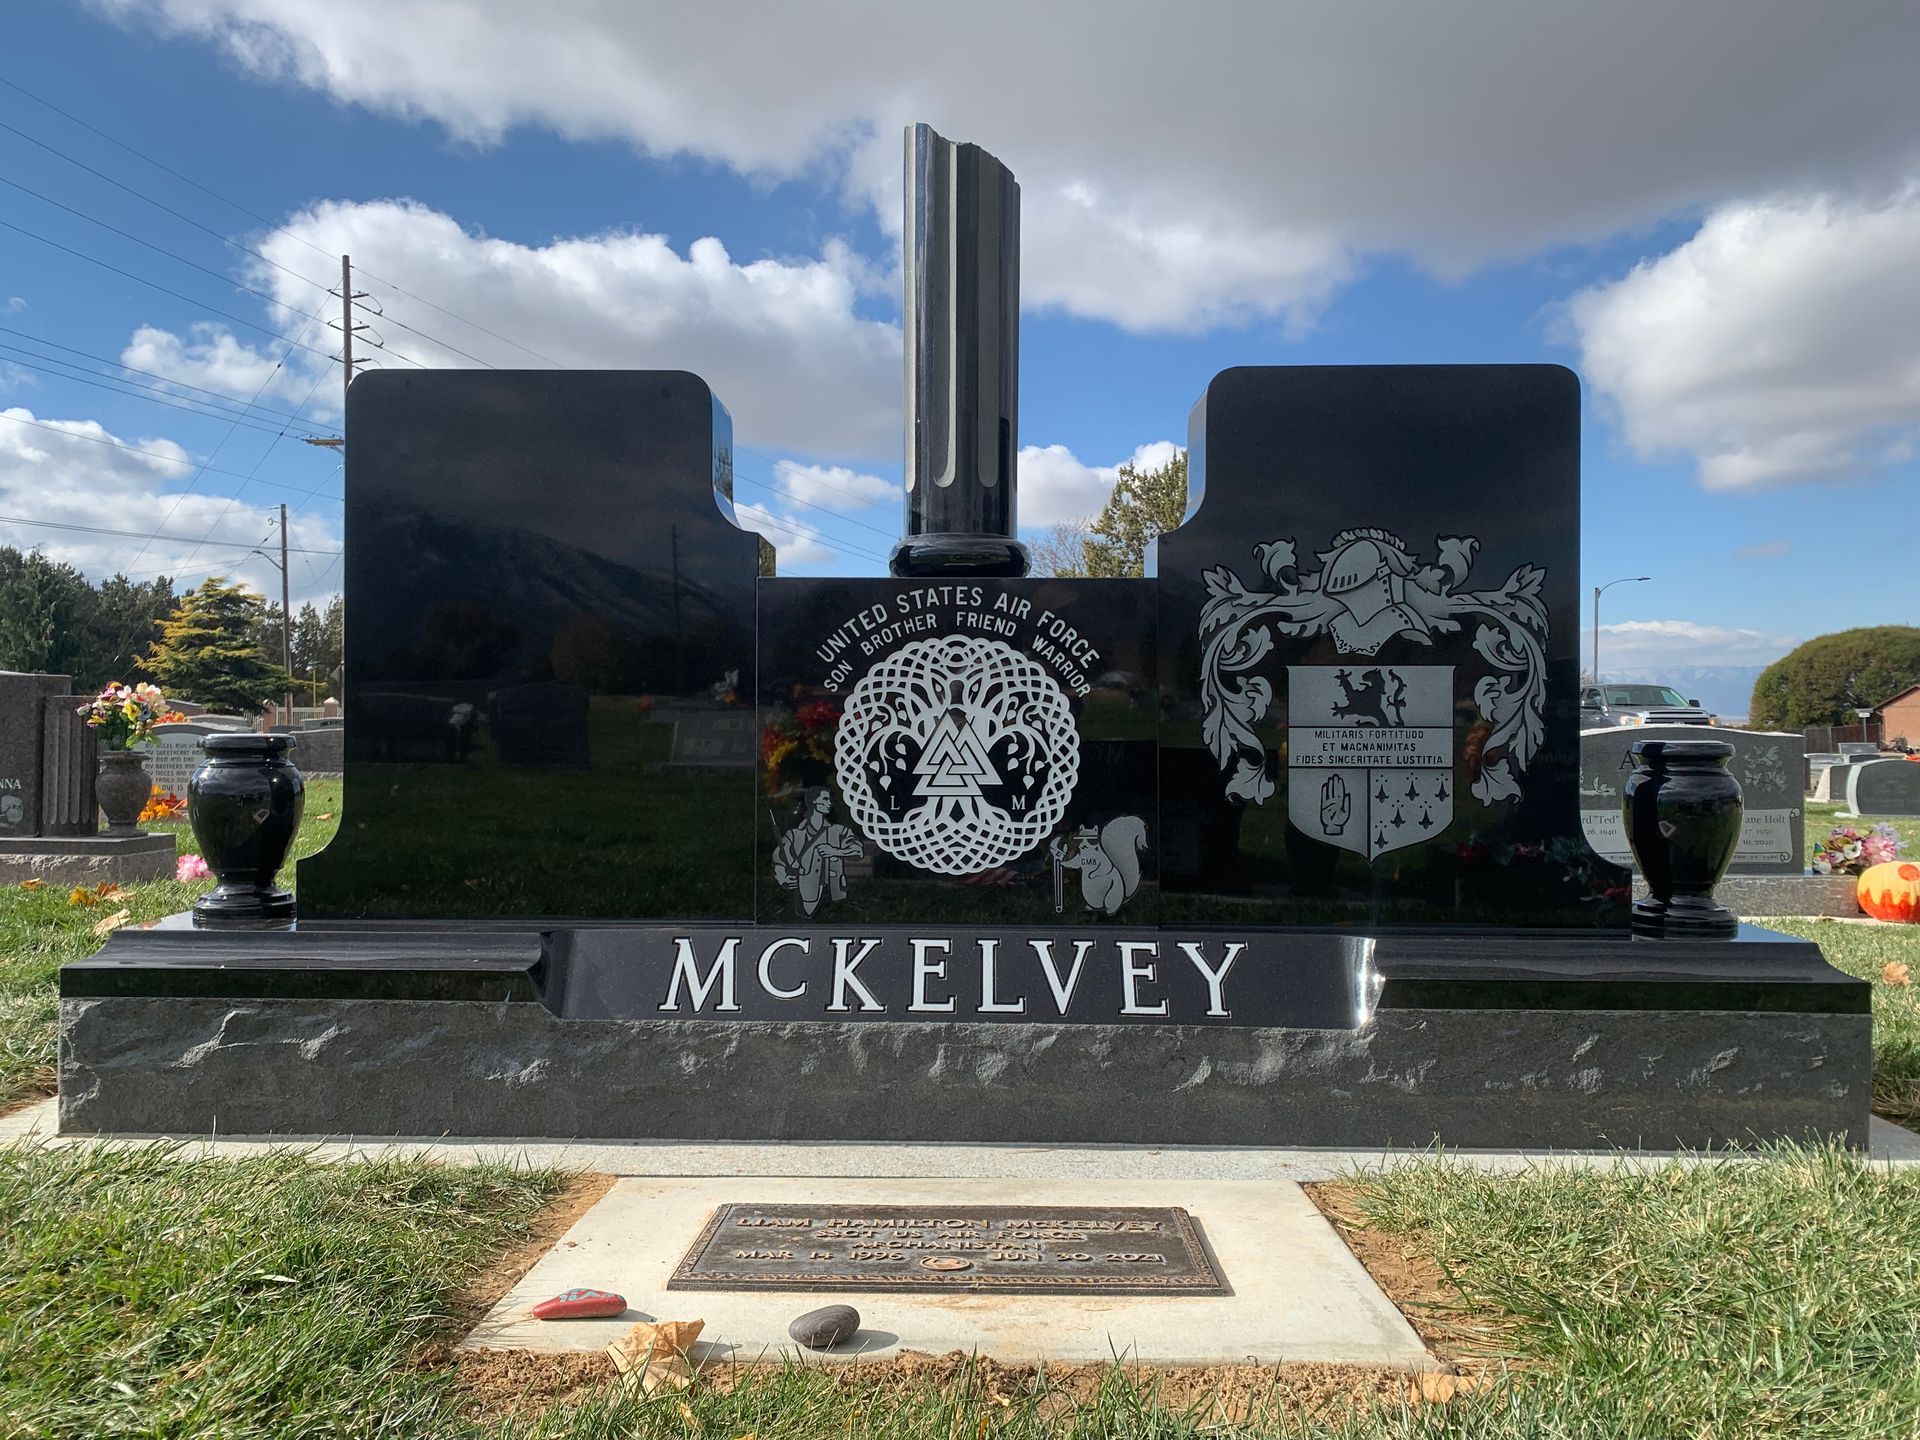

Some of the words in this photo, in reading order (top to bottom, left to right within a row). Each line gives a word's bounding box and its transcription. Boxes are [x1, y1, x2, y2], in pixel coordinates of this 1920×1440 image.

[816, 603, 889, 664] UNITED
[896, 586, 984, 614] STATES
[993, 592, 1032, 620] AIR
[1036, 610, 1101, 670] FORCE
[823, 660, 854, 694] SON
[859, 613, 938, 657] BROTHER
[956, 611, 1017, 638] FRIEND
[1031, 634, 1092, 699] WARRIOR
[1314, 730, 1364, 739] MILITARIS
[1369, 730, 1424, 739] FORTITUDO
[1322, 742, 1335, 752] ET
[1340, 742, 1416, 752] MAGNANIMITAS
[1296, 755, 1324, 765] FIDES
[1328, 755, 1392, 765] SINCERITATE
[1396, 755, 1443, 765] LUSTITIA
[890, 795, 900, 810] L
[1012, 794, 1026, 810] M
[735, 1217, 813, 1228] LIAM
[826, 1217, 990, 1229] HAMILTON
[815, 1229, 879, 1239] SSGT
[893, 1230, 927, 1239] US
[937, 1230, 981, 1240] AIR
[998, 1230, 1086, 1241] FORCE
[851, 1240, 1042, 1251] AFGHANISTAN
[735, 1250, 794, 1260] MAR
[808, 1251, 834, 1260] 14
[849, 1251, 904, 1261] 1996
[990, 1251, 1040, 1262] JUN
[1056, 1252, 1092, 1262] 30
[1105, 1253, 1165, 1263] 2021
